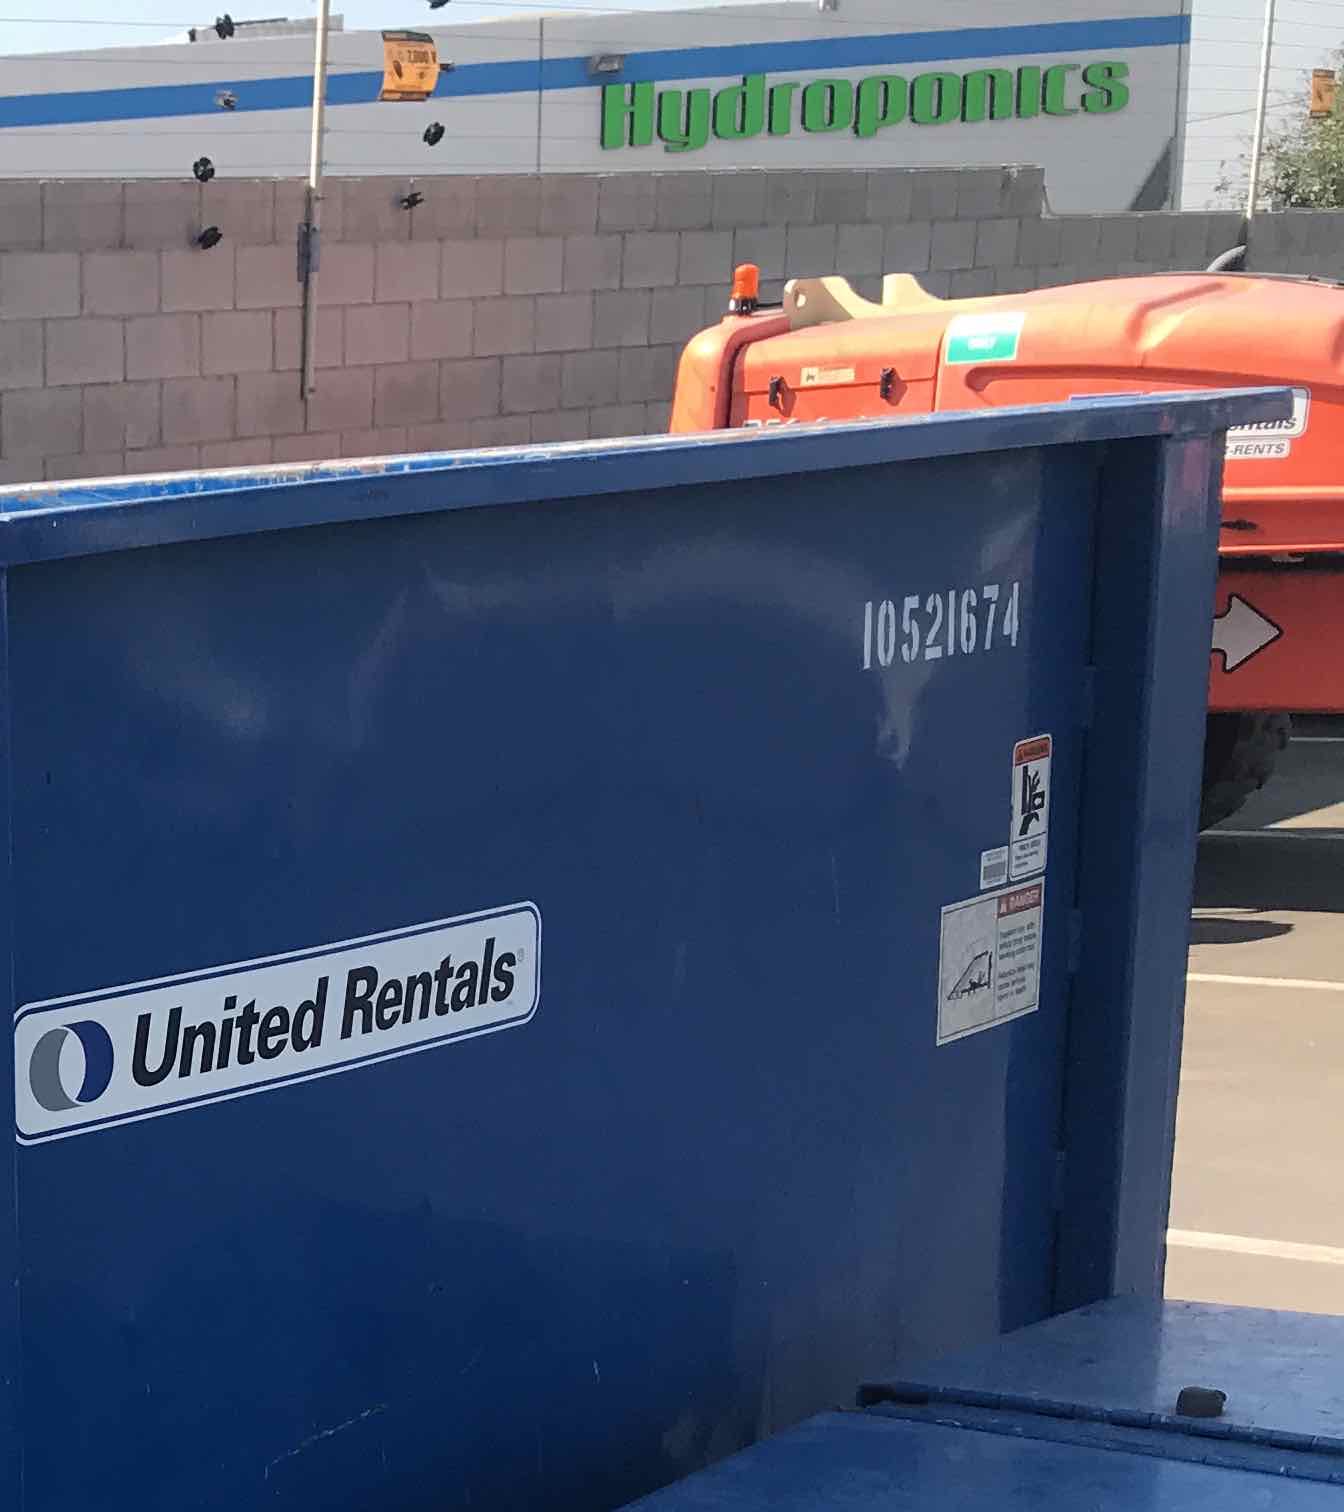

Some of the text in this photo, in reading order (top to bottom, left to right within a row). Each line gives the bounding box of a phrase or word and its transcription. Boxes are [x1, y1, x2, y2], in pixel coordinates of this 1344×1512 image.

[600, 61, 1130, 153] Hydroponics
[861, 580, 1020, 670] 10521674
[131, 937, 519, 1087] United Rentals
